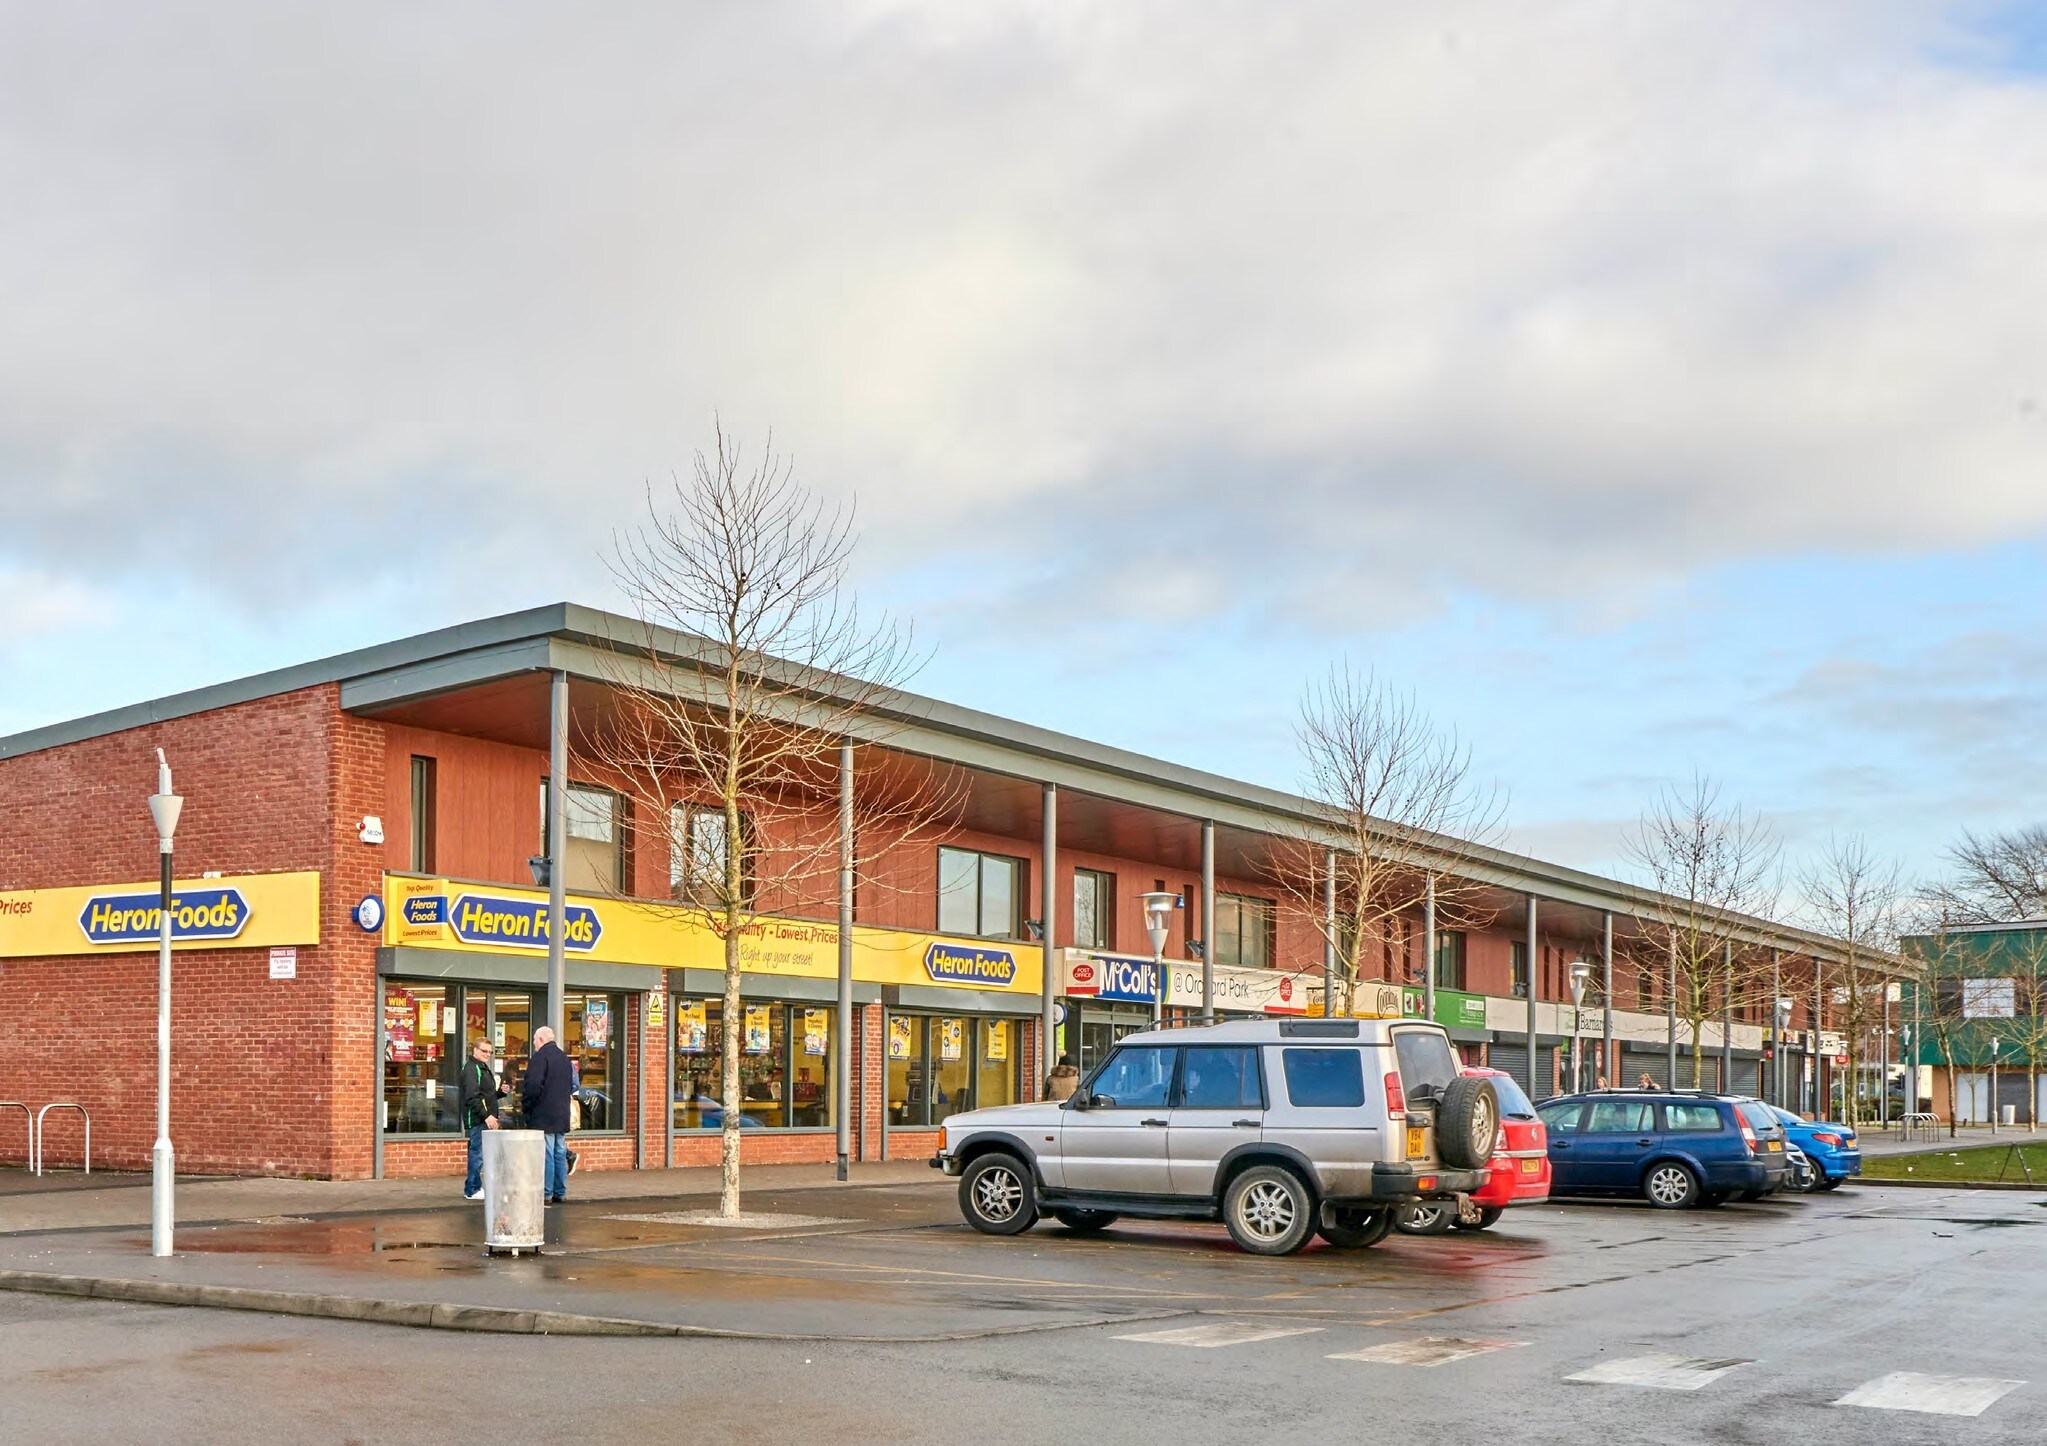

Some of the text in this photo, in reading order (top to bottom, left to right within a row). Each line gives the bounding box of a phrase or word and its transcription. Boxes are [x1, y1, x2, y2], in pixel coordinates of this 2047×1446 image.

[89, 895, 238, 933] Heron Foods
[410, 899, 438, 910] Heron
[410, 910, 437, 922] Foods
[460, 902, 530, 937] Heron
[775, 923, 809, 942] Lowest
[810, 926, 839, 944] Prices
[740, 943, 761, 968] Right
[763, 951, 773, 968] up
[774, 952, 791, 969] your
[932, 949, 1011, 979] Heron Foods
[1101, 961, 1156, 995] McColl's
[1185, 973, 1227, 997] Orcard
[1229, 978, 1250, 999] Park
[388, 996, 407, 1007] WIN!
[1580, 1013, 1613, 1032] Barnars
